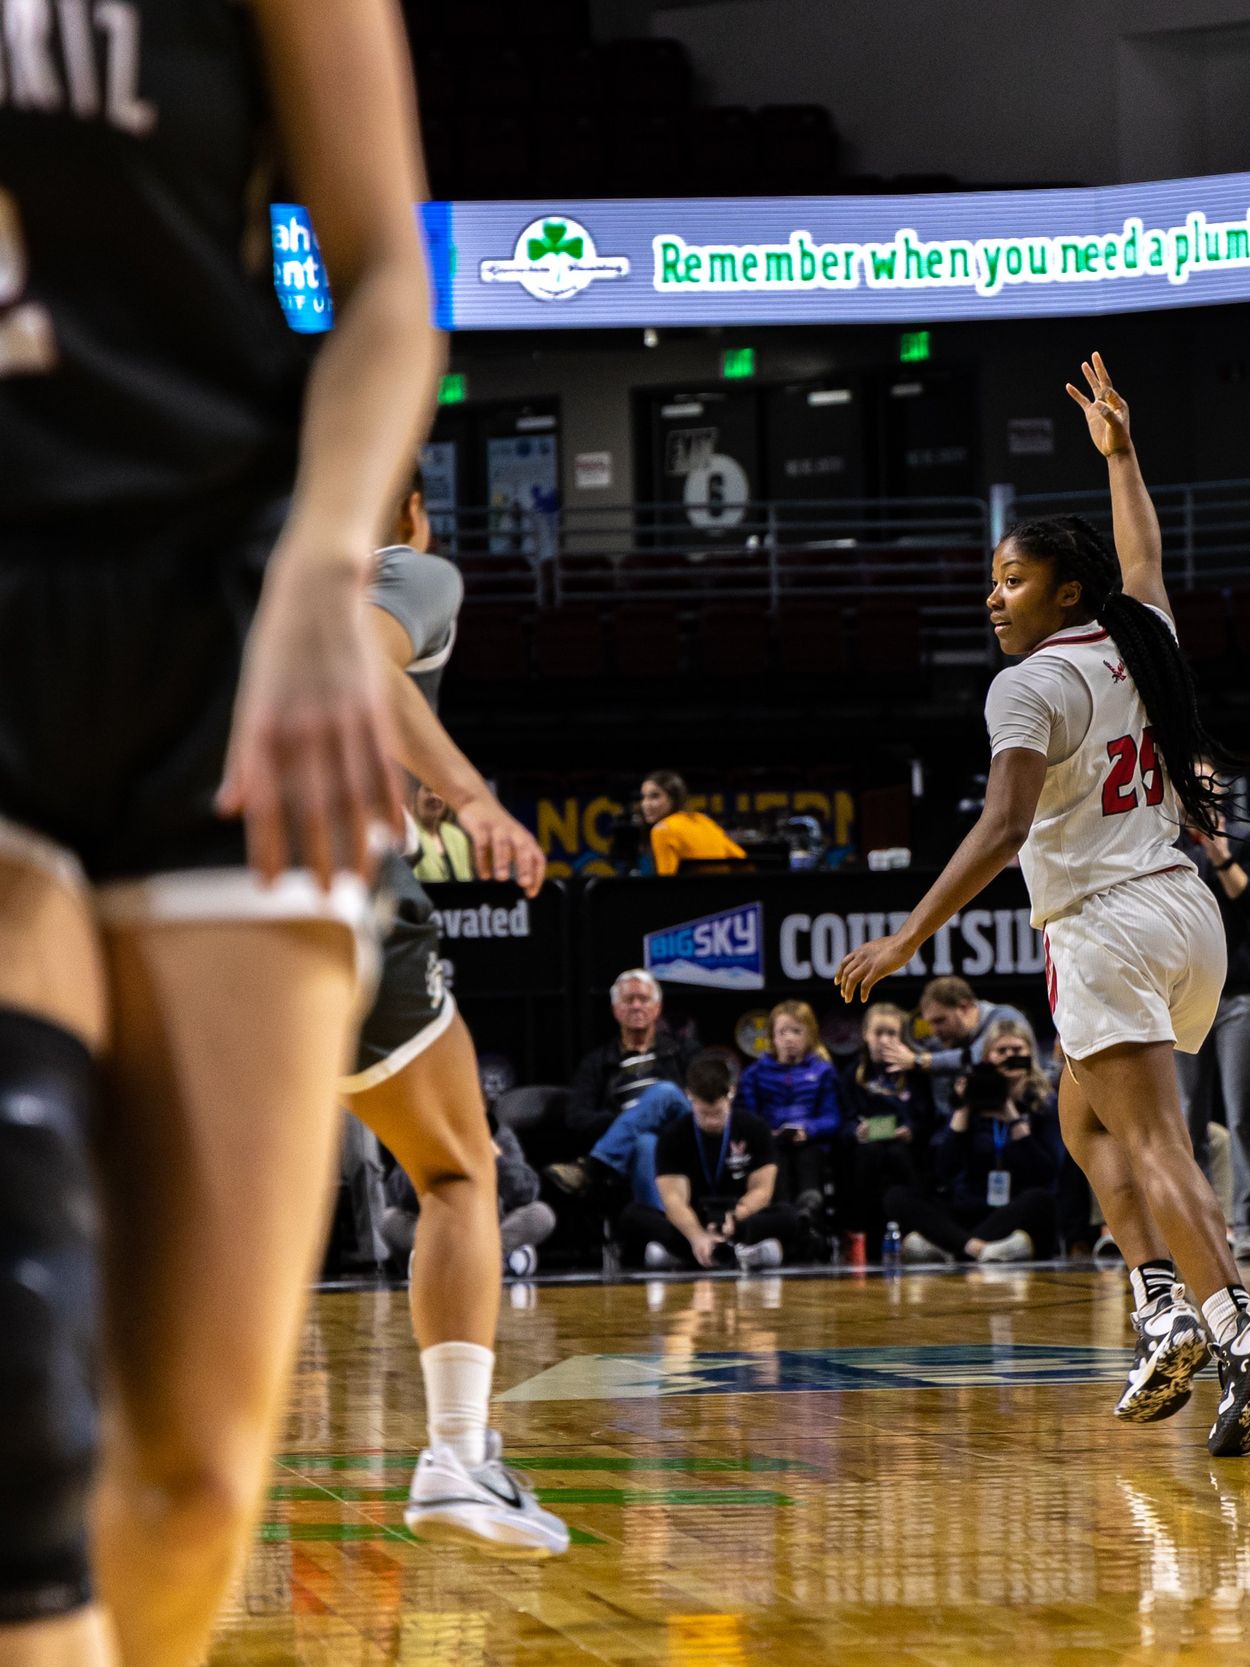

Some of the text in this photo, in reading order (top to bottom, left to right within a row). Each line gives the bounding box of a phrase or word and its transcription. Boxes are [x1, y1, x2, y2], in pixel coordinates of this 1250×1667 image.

[659, 236, 857, 285] Remember
[867, 235, 972, 282] when
[981, 242, 1048, 290] you
[1059, 225, 1140, 275] need
[1146, 236, 1166, 269] a
